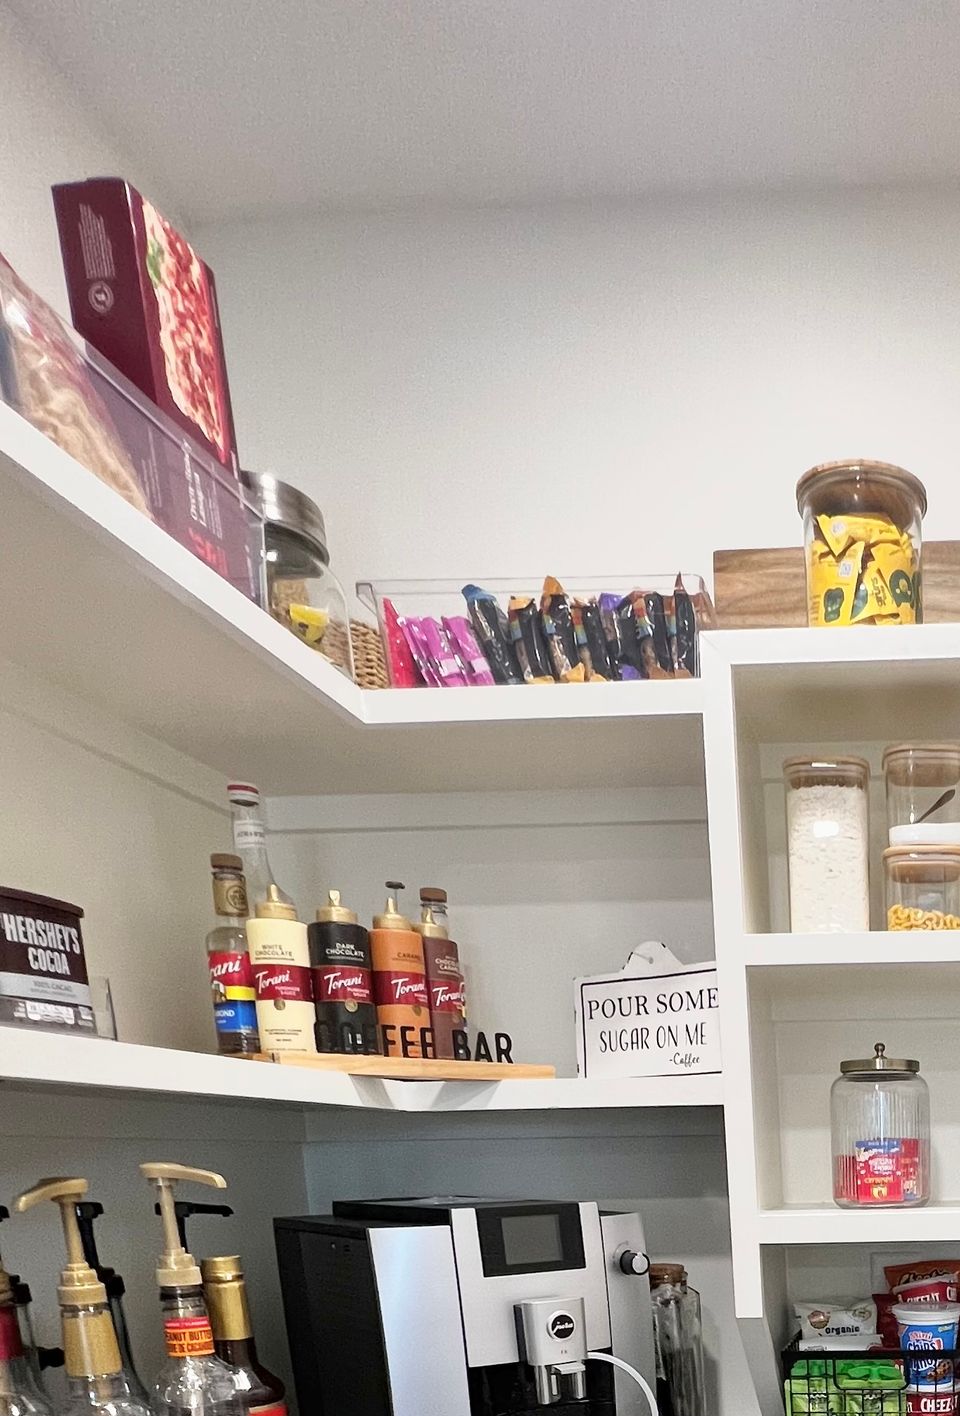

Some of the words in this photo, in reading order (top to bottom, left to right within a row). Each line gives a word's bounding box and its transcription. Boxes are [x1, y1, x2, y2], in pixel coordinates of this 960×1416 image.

[2, 913, 81, 954] HERSHEY'S
[255, 949, 293, 958] CHOCOLATE
[326, 947, 364, 958] CHOCOLATE
[335, 942, 355, 950] DARK
[28, 947, 71, 975] COCOA
[255, 970, 290, 994] Torani
[324, 972, 363, 995] Torani
[588, 995, 650, 1020] POUR
[656, 987, 720, 1014] SOME
[452, 1028, 514, 1064] BAR
[600, 1027, 650, 1054] SUGAR
[656, 1025, 678, 1049] ON
[685, 1022, 708, 1046] ME
[825, 1326, 860, 1336] organic
